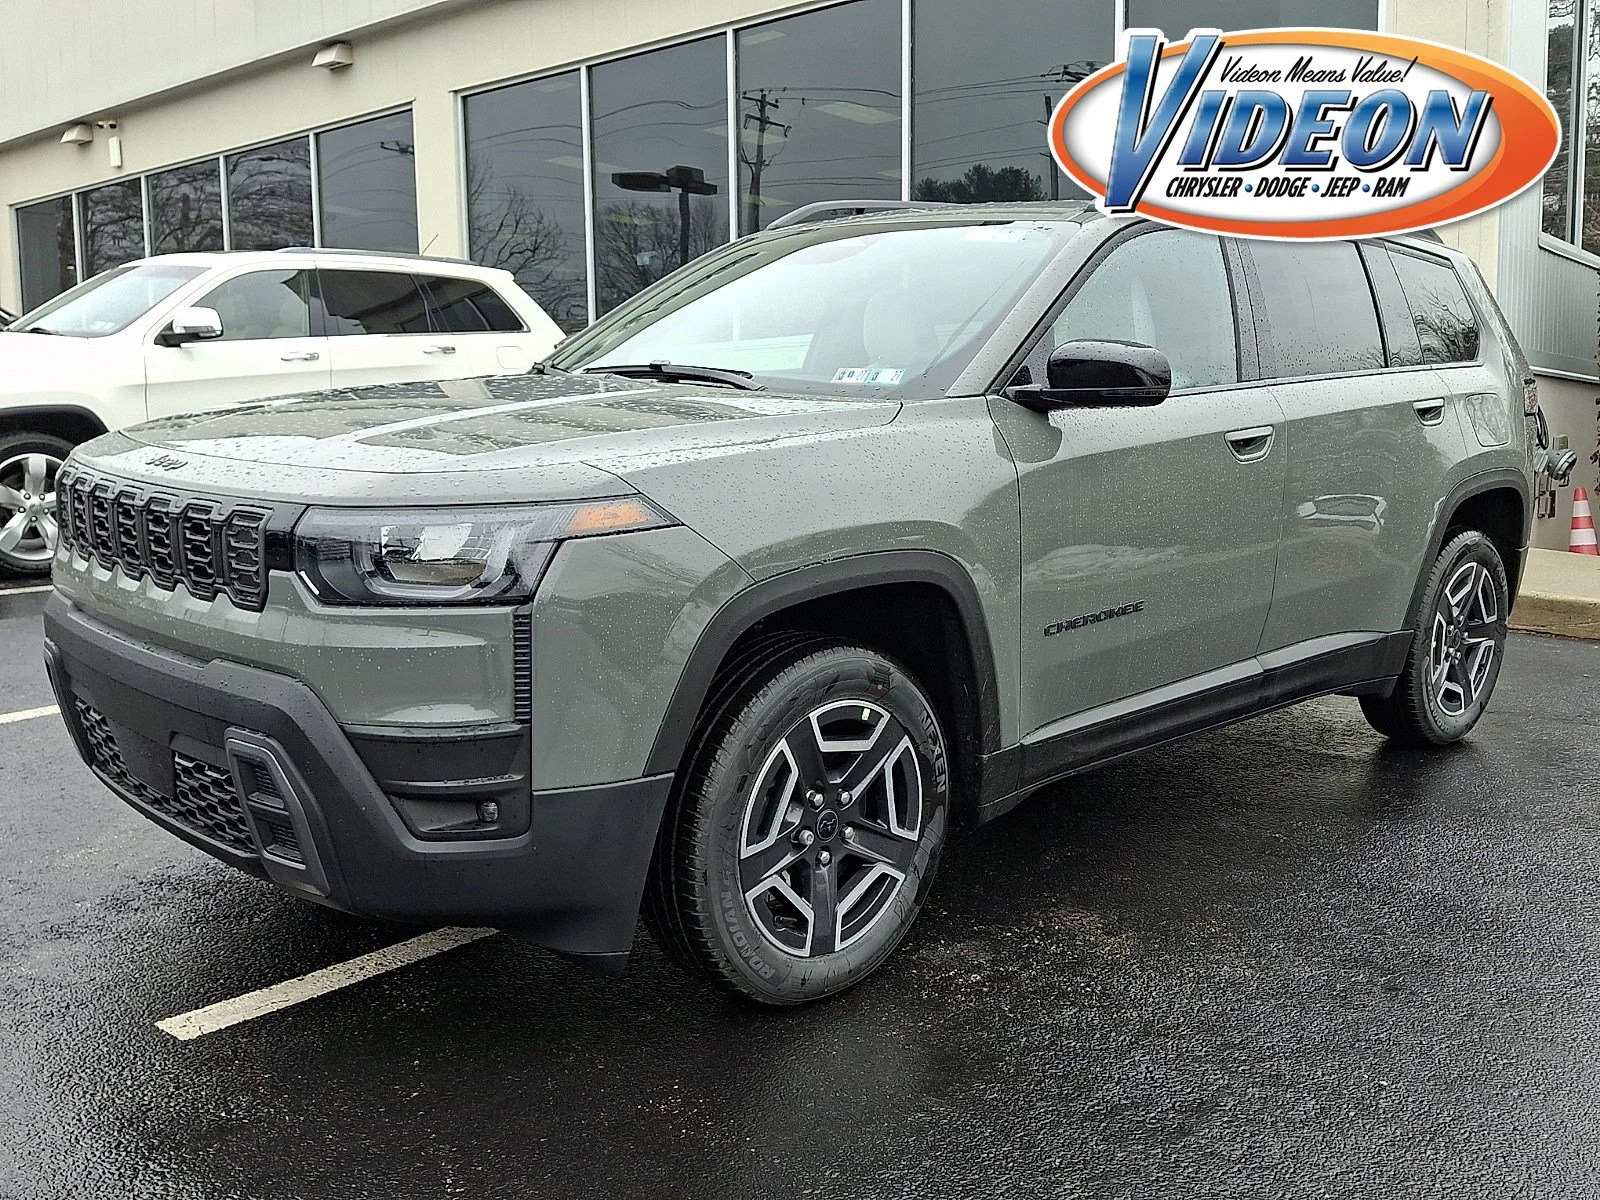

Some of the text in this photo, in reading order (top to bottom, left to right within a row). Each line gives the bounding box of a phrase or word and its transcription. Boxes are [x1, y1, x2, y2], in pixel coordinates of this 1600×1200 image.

[145, 454, 189, 472] Jeep
[1043, 600, 1145, 637] CHEROKEE
[918, 710, 947, 794] NEXEN
